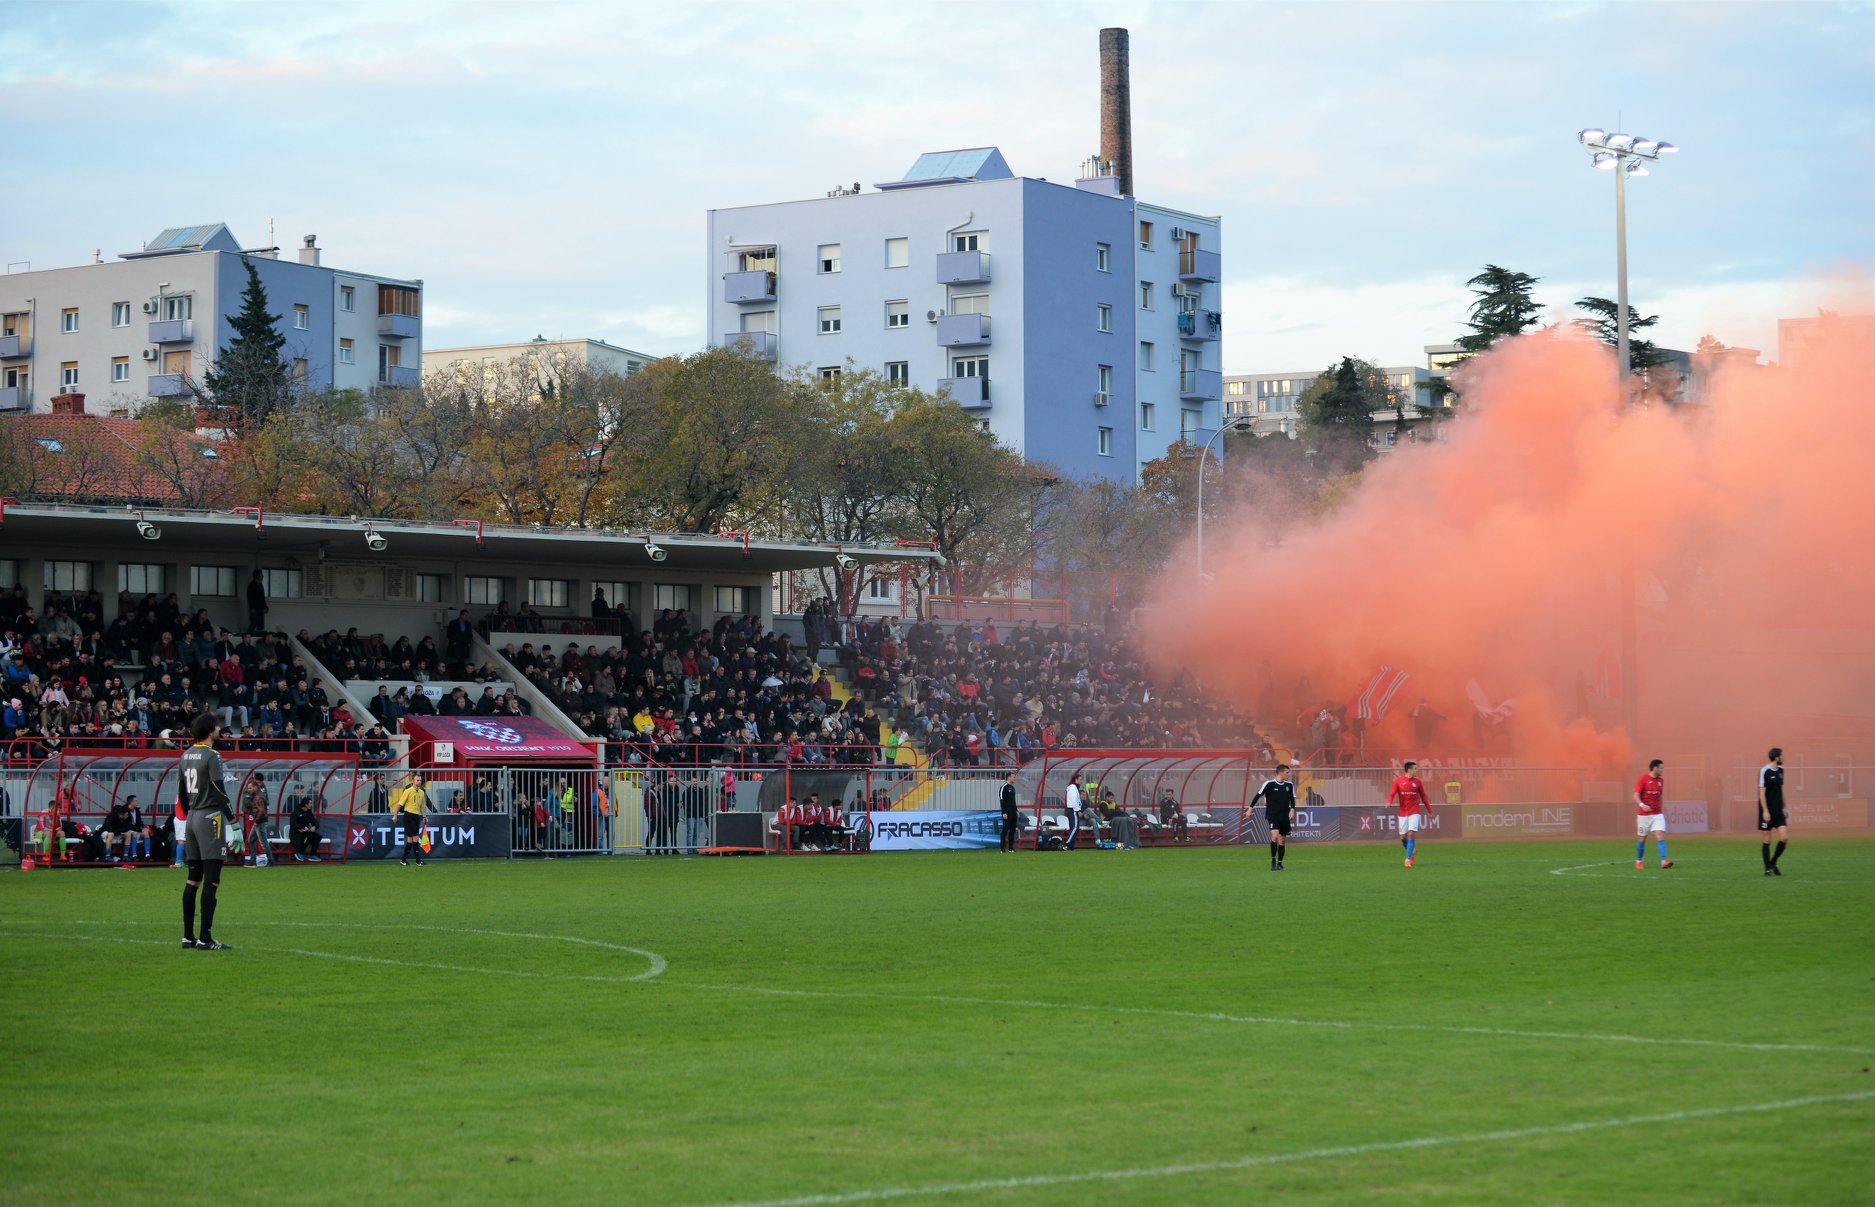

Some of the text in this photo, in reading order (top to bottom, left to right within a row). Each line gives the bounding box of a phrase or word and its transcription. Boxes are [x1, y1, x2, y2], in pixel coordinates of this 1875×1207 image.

[184, 768, 199, 794] 12
[878, 821, 963, 839] FRACASSO
[1376, 814, 1440, 830] TEUM
[376, 826, 475, 846] TETUM
